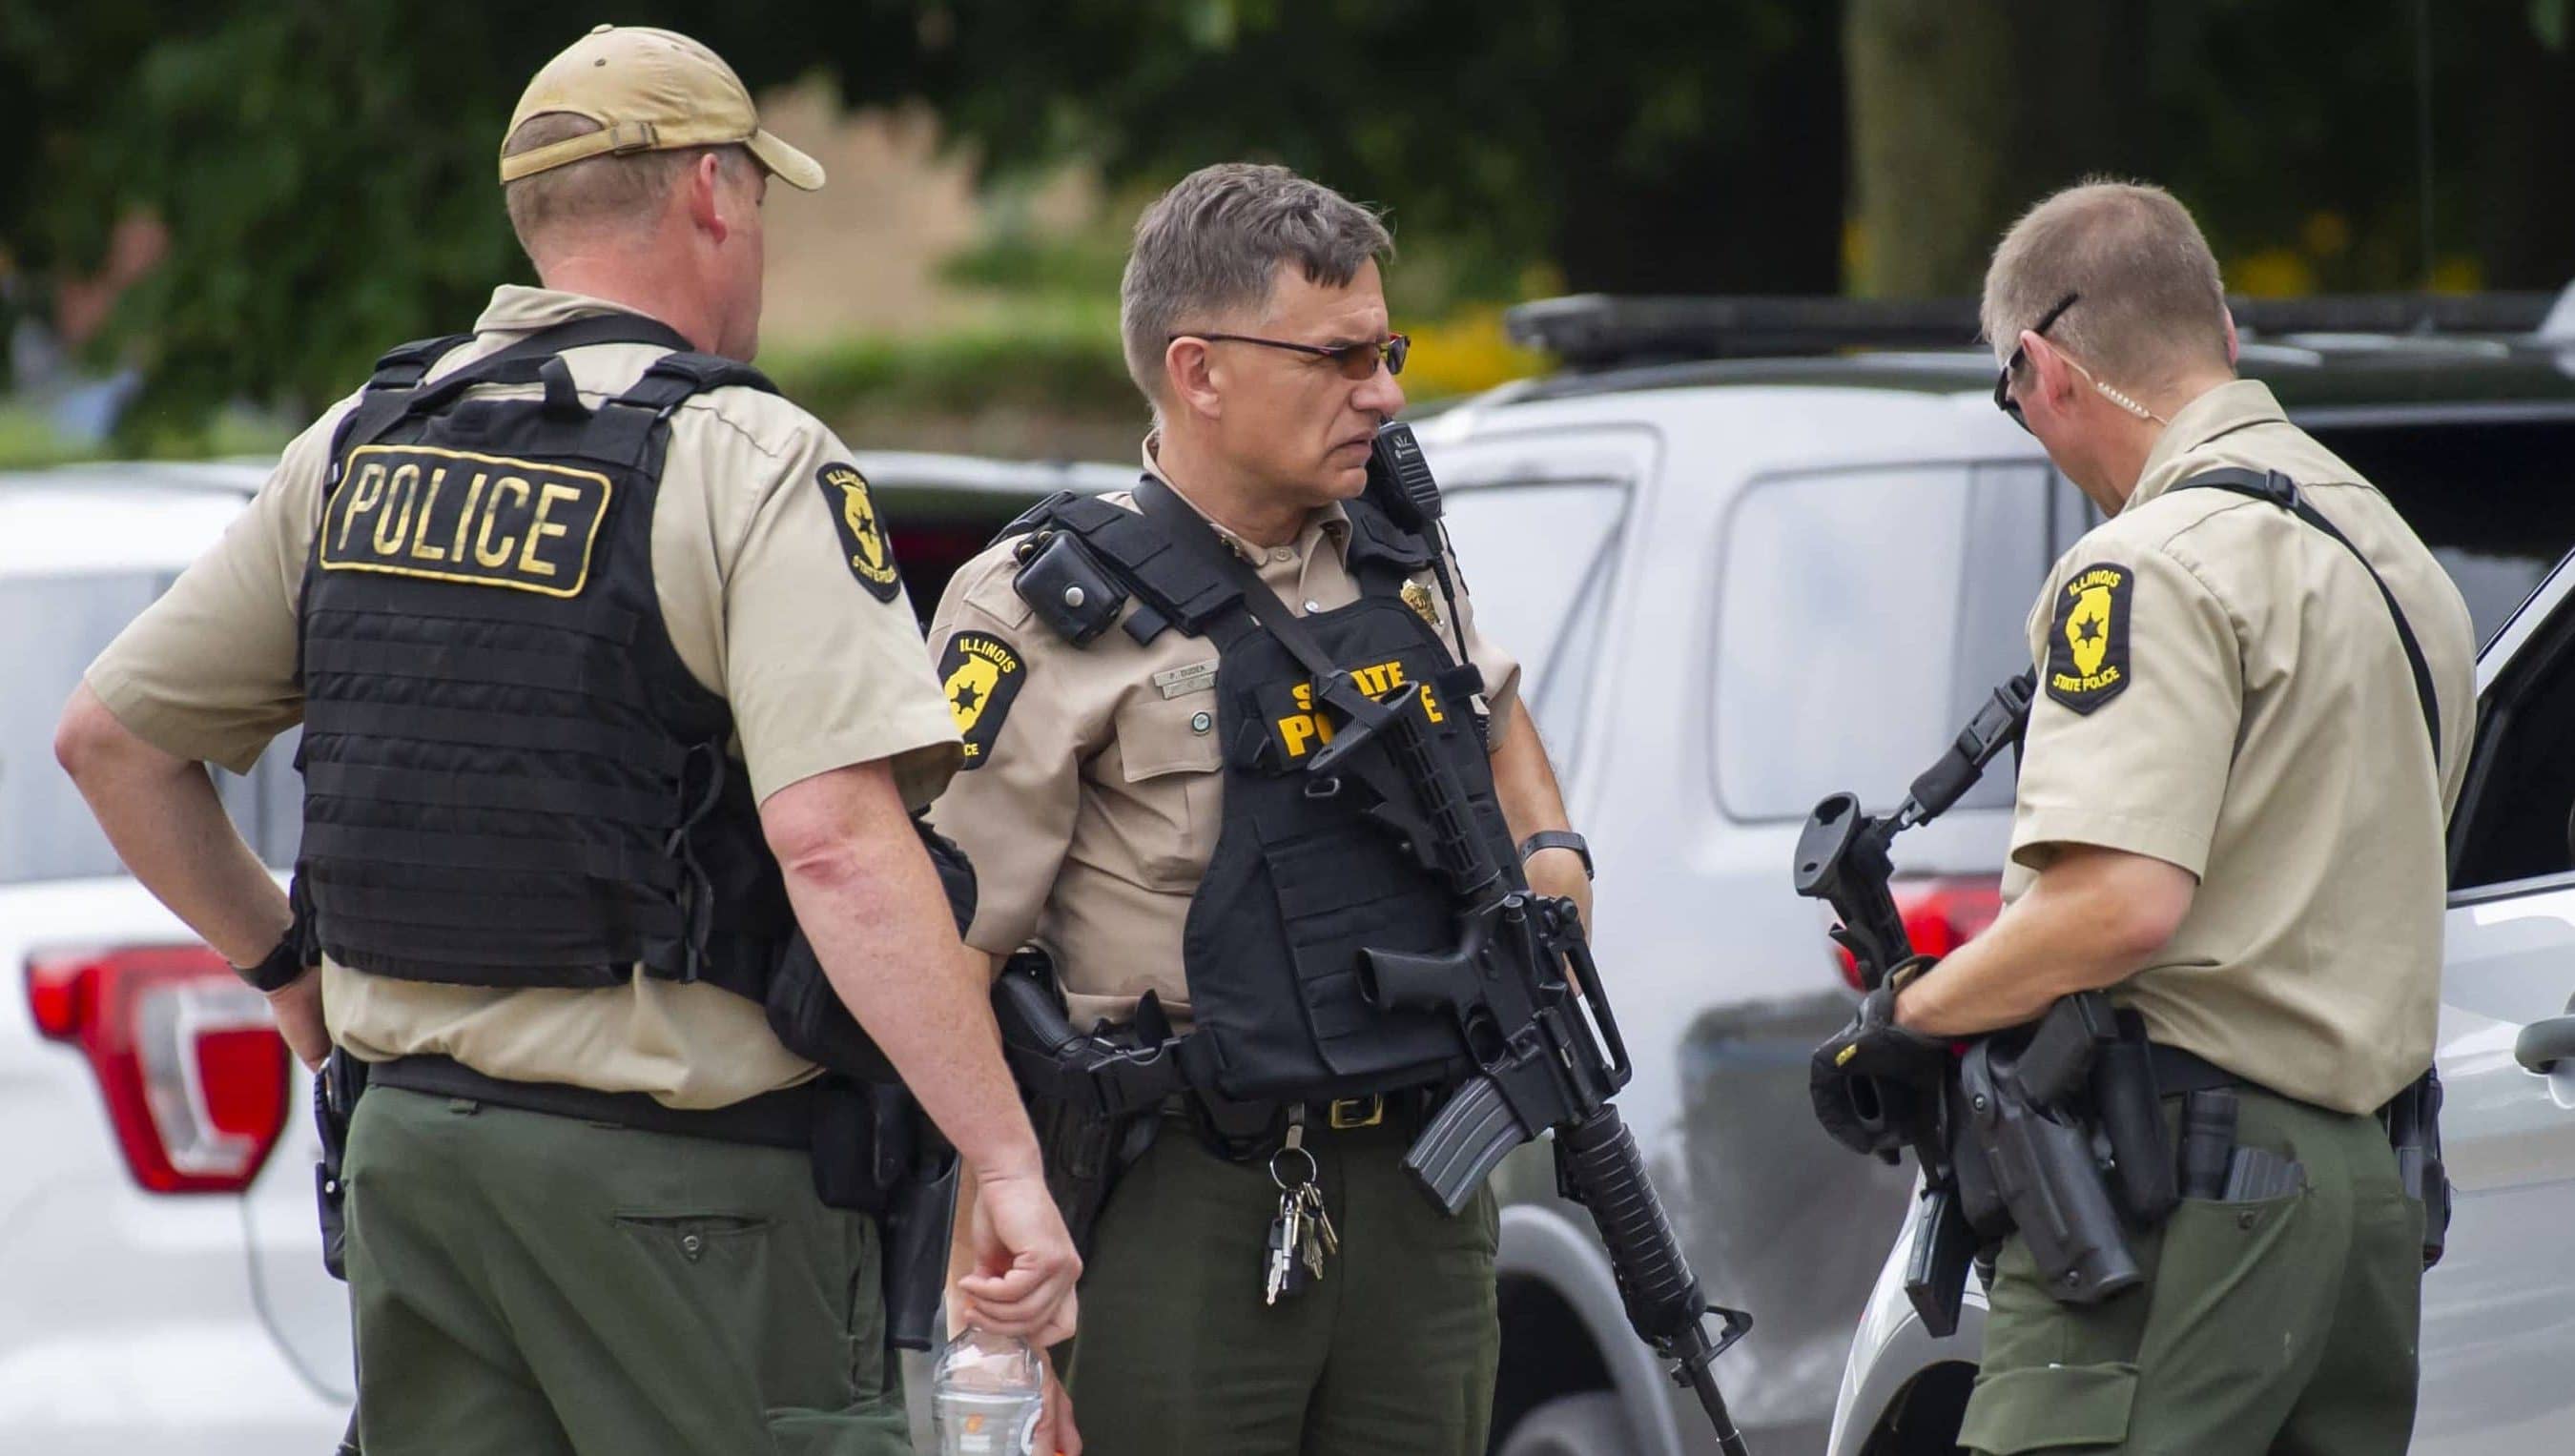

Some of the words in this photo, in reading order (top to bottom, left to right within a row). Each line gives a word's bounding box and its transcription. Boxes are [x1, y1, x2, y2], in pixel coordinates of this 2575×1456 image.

[338, 462, 581, 576] POLICE
[2069, 570, 2121, 596] ILLINOIS
[959, 639, 1016, 673] ILLINOIS
[2052, 673, 2081, 691] STATE
[2083, 666, 2120, 691] POLICE
